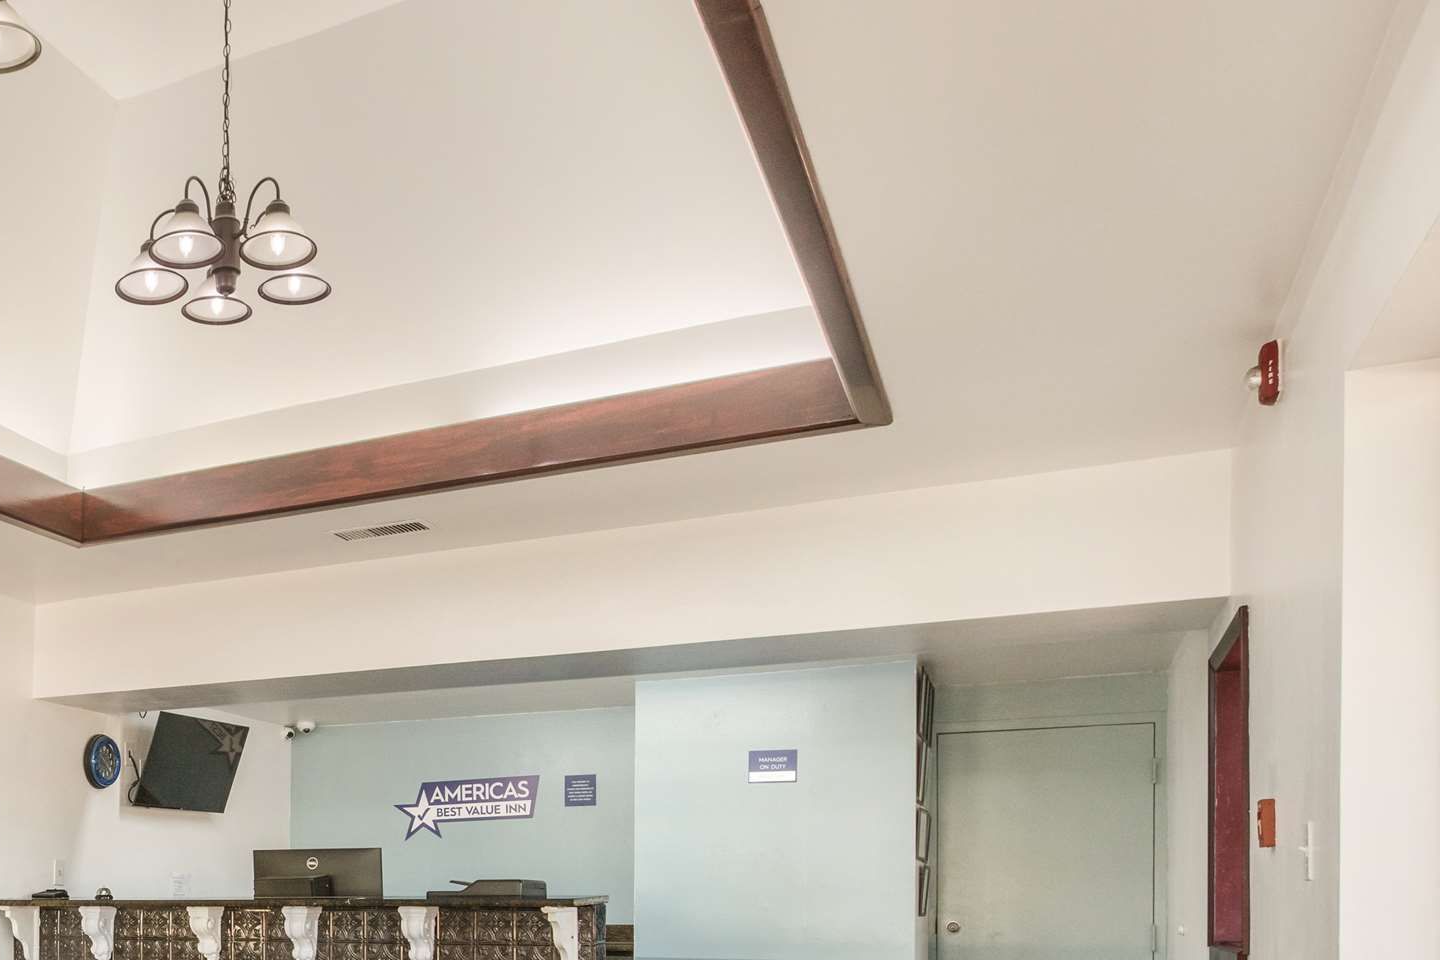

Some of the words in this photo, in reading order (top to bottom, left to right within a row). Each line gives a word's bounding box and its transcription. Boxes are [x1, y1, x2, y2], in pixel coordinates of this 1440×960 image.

[430, 780, 530, 803] AMERICAS
[436, 806, 462, 817] BEST
[465, 804, 501, 816] VALUE
[505, 803, 527, 814] INN
